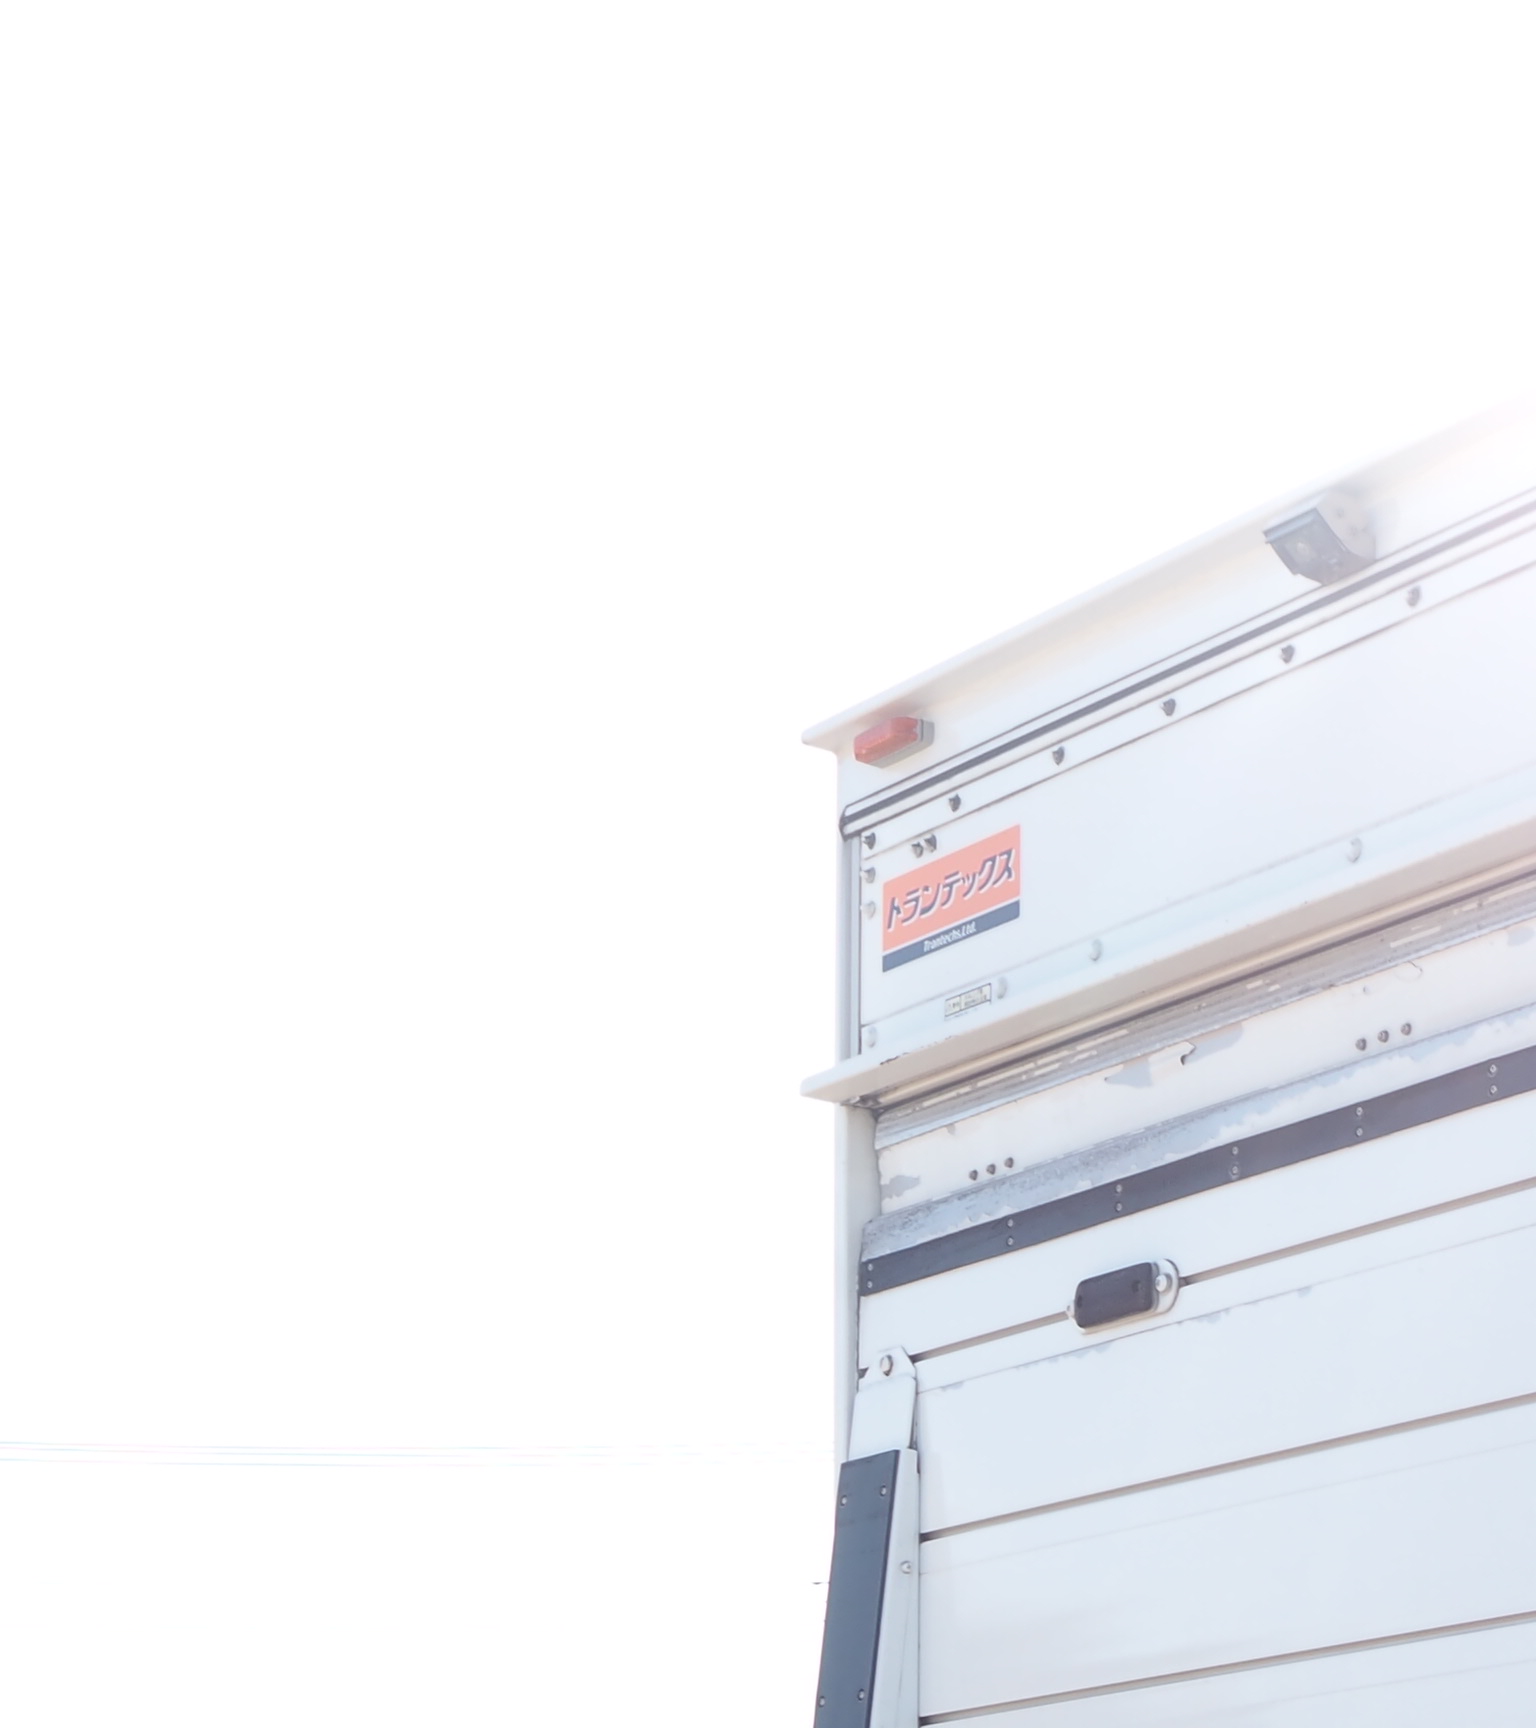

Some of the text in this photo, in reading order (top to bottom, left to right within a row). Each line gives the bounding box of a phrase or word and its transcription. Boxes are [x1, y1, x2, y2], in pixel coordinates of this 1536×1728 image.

[887, 847, 1016, 932] トランテックス
